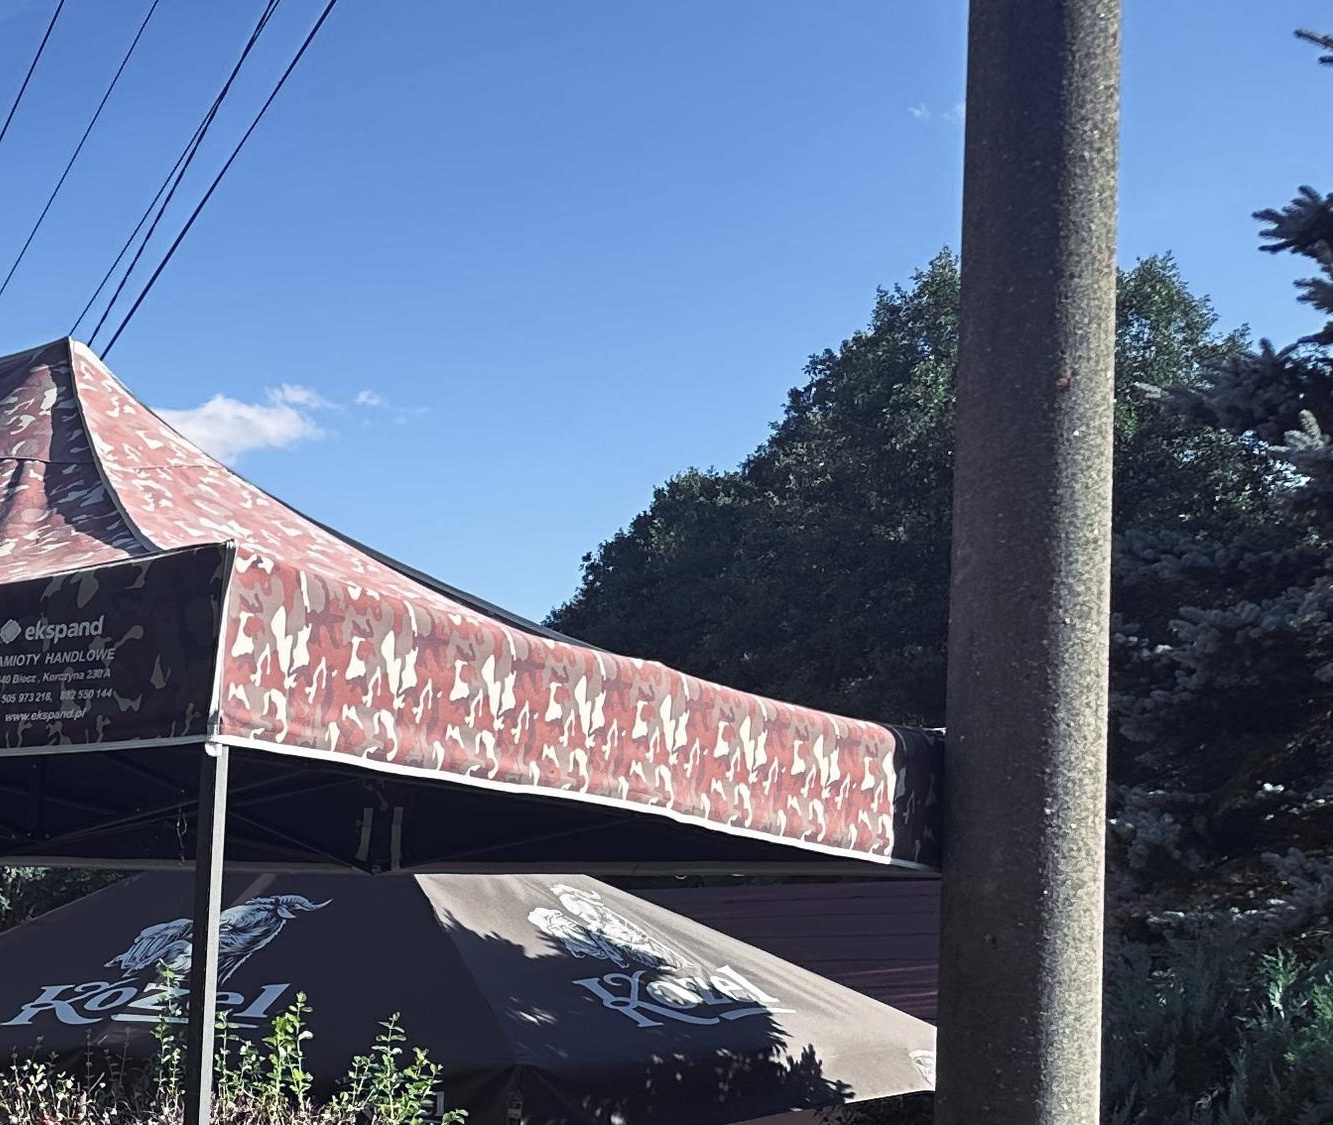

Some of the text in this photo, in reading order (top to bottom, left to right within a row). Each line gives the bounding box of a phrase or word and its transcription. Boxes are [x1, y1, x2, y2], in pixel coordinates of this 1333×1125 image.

[24, 615, 105, 644] ekspand
[44, 650, 116, 665] HANDLOWE
[18, 692, 34, 703] 973
[4, 709, 86, 723] www.ekspand.pl
[572, 965, 783, 1028] Kozel
